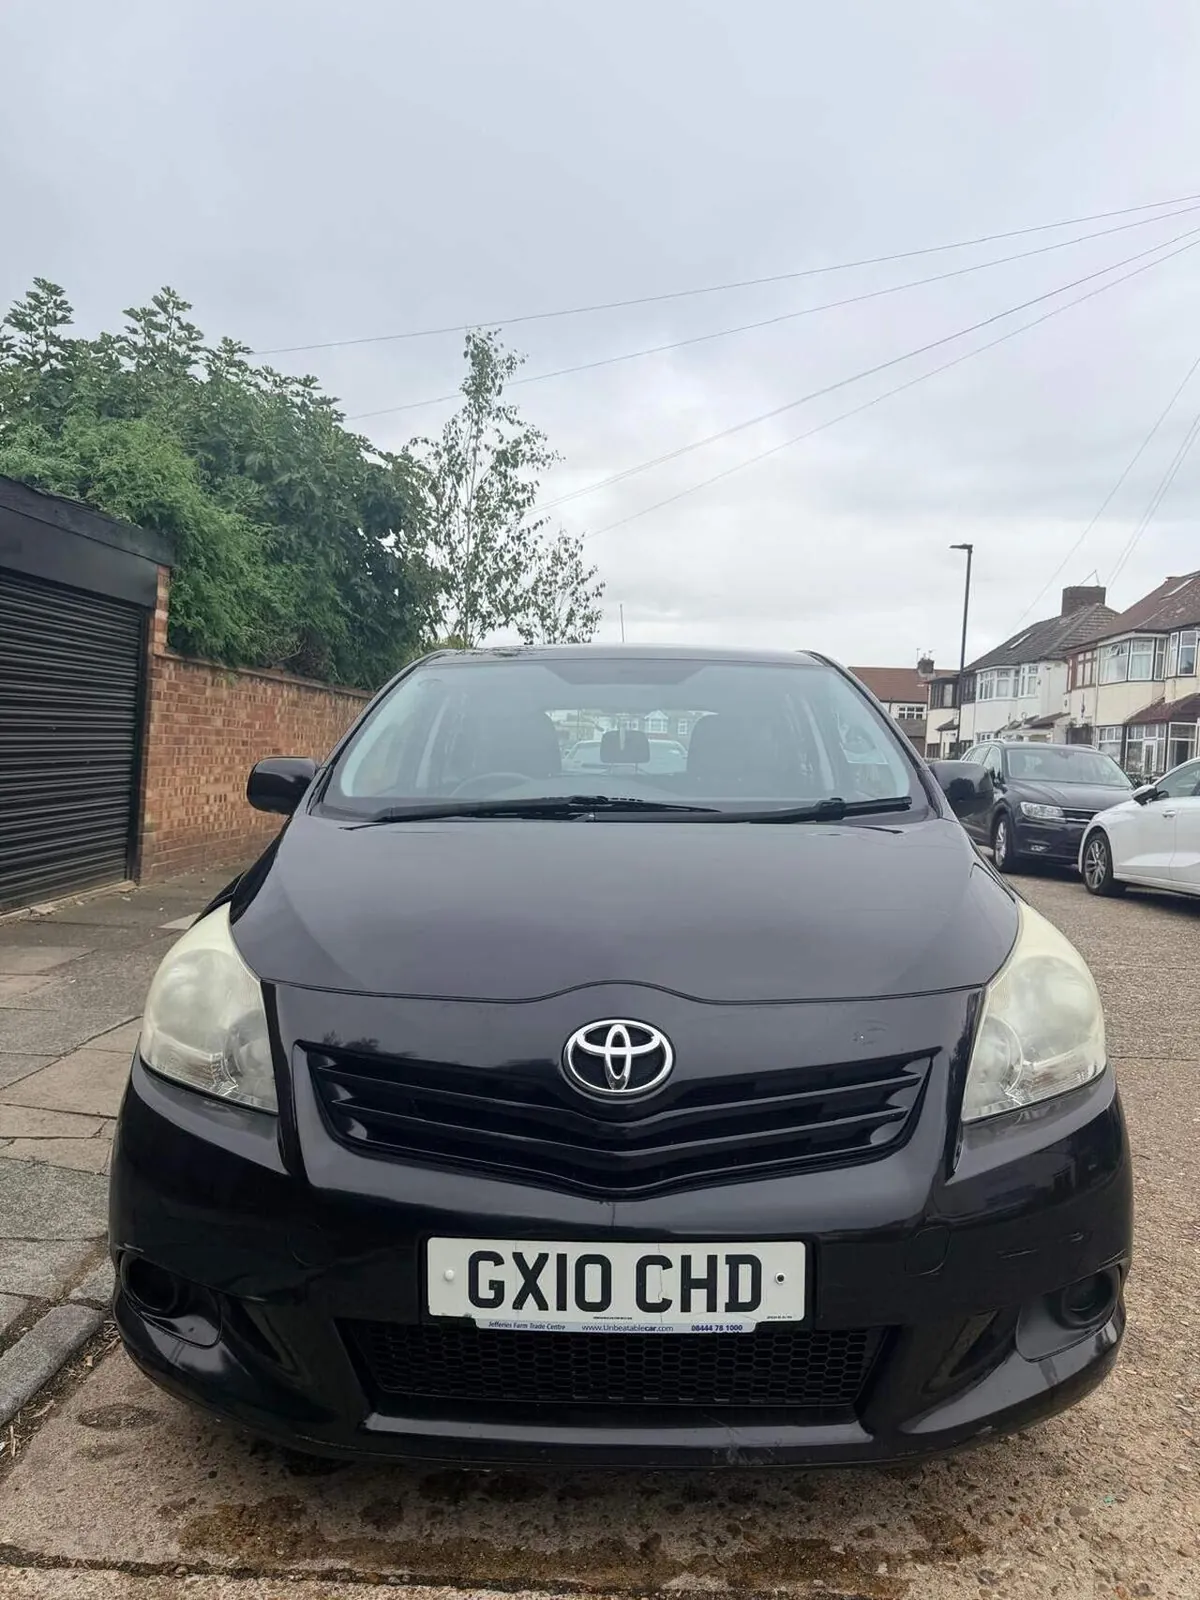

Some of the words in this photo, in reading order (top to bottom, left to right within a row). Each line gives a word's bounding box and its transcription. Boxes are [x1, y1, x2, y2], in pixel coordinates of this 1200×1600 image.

[468, 1250, 612, 1312] GX10
[636, 1254, 763, 1313] CHD
[513, 1321, 528, 1329] Farm
[529, 1322, 545, 1330] Trade
[546, 1322, 566, 1330] Centre
[581, 1323, 674, 1332] www.Unbeatablecar.com
[714, 1324, 724, 1332] 78
